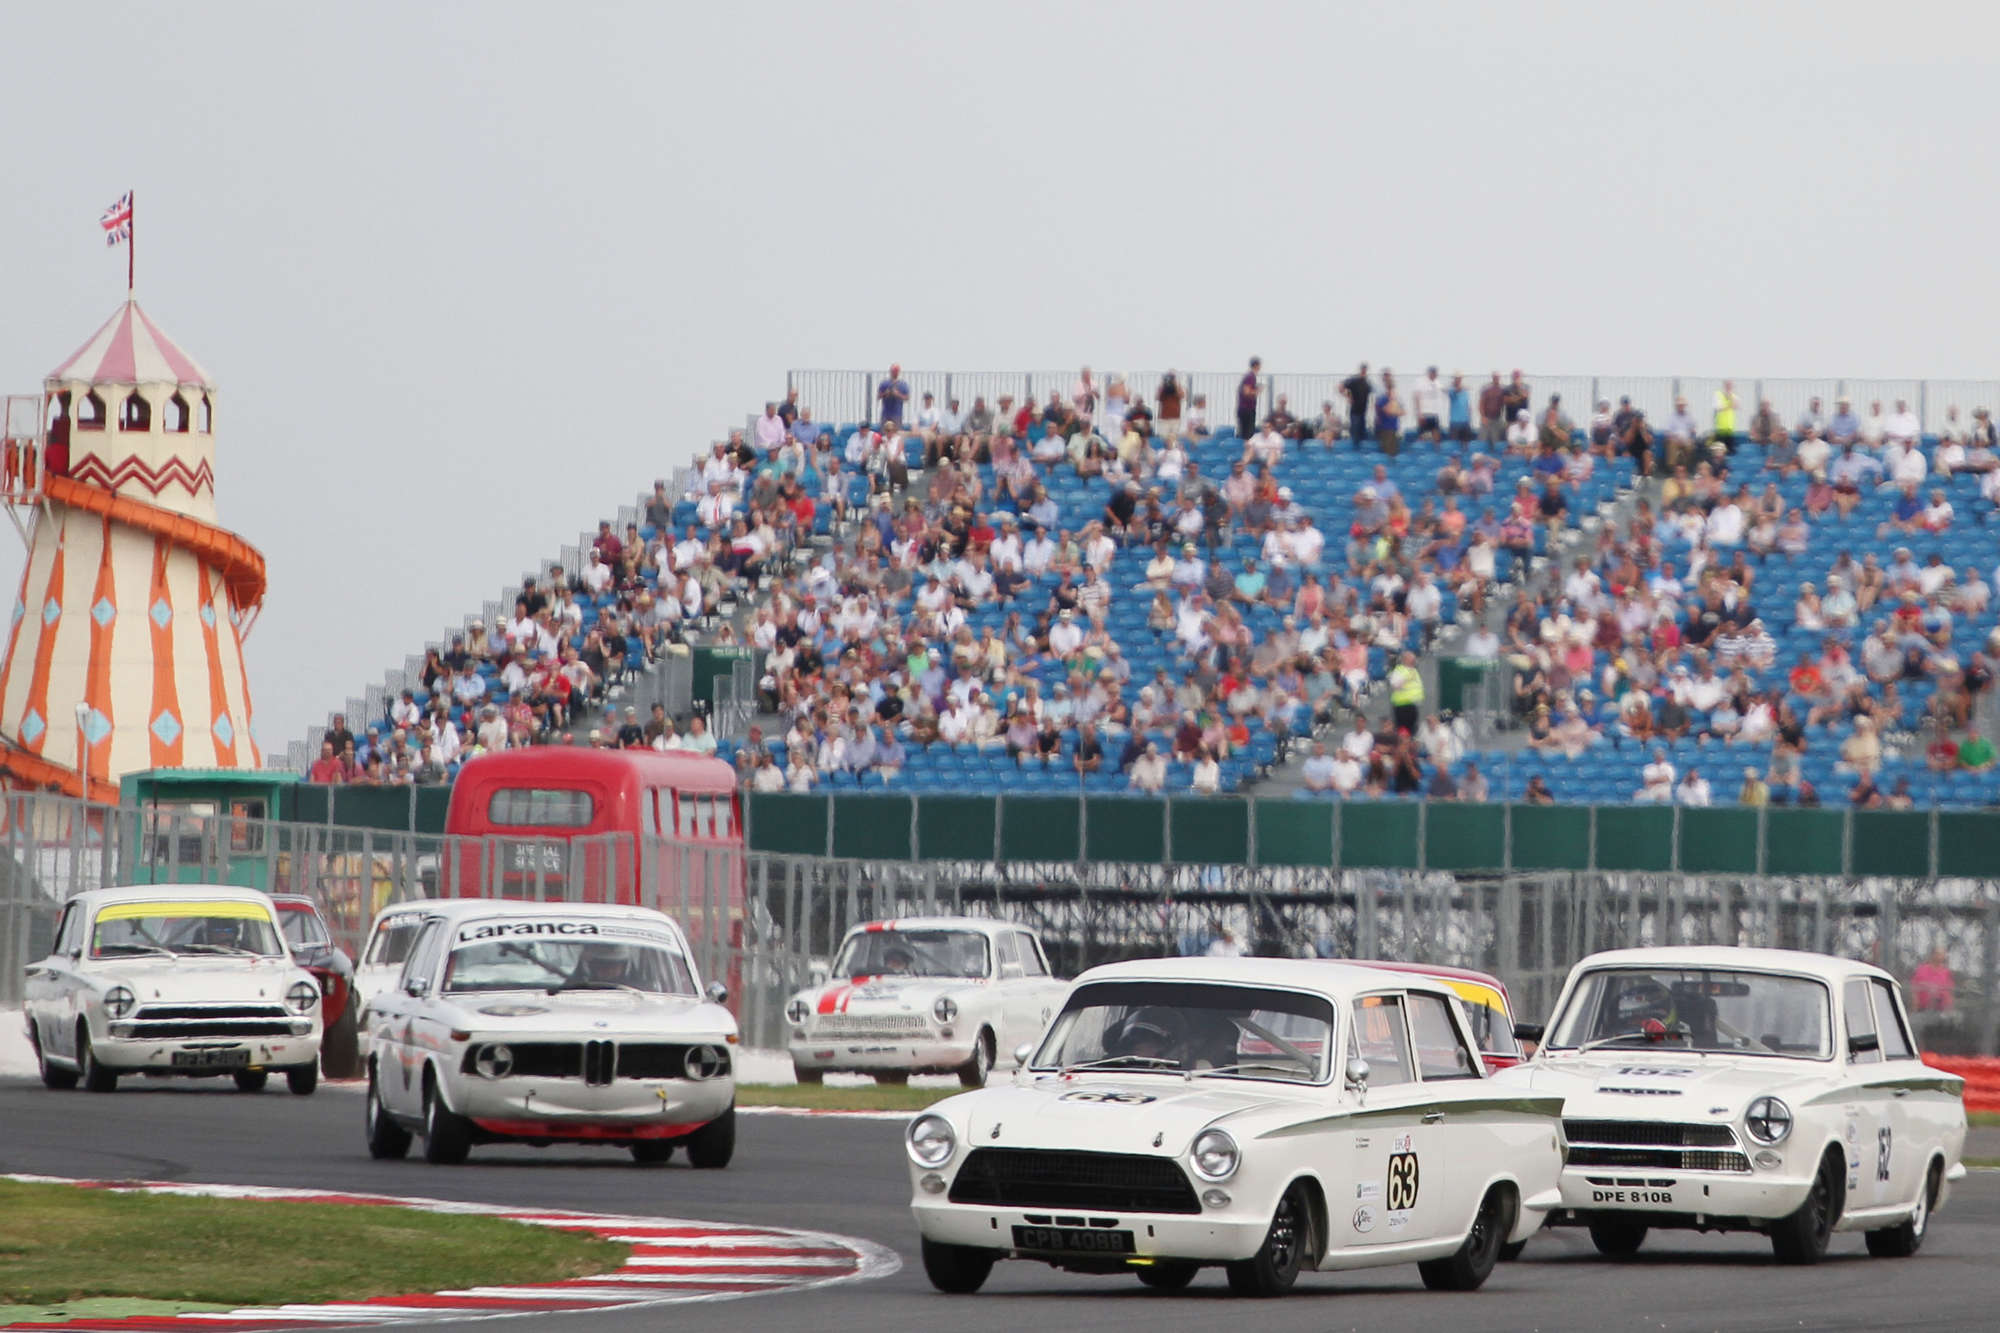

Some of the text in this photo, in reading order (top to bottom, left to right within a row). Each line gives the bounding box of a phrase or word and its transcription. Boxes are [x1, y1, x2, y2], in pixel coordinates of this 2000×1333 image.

[515, 843, 560, 857] SPEIAL
[459, 922, 599, 943] Laranca
[1876, 1126, 1892, 1182] 152
[1389, 1154, 1416, 1210] 63
[1592, 1190, 1673, 1204] DPE 810B
[1023, 1230, 1064, 1248] CPB
